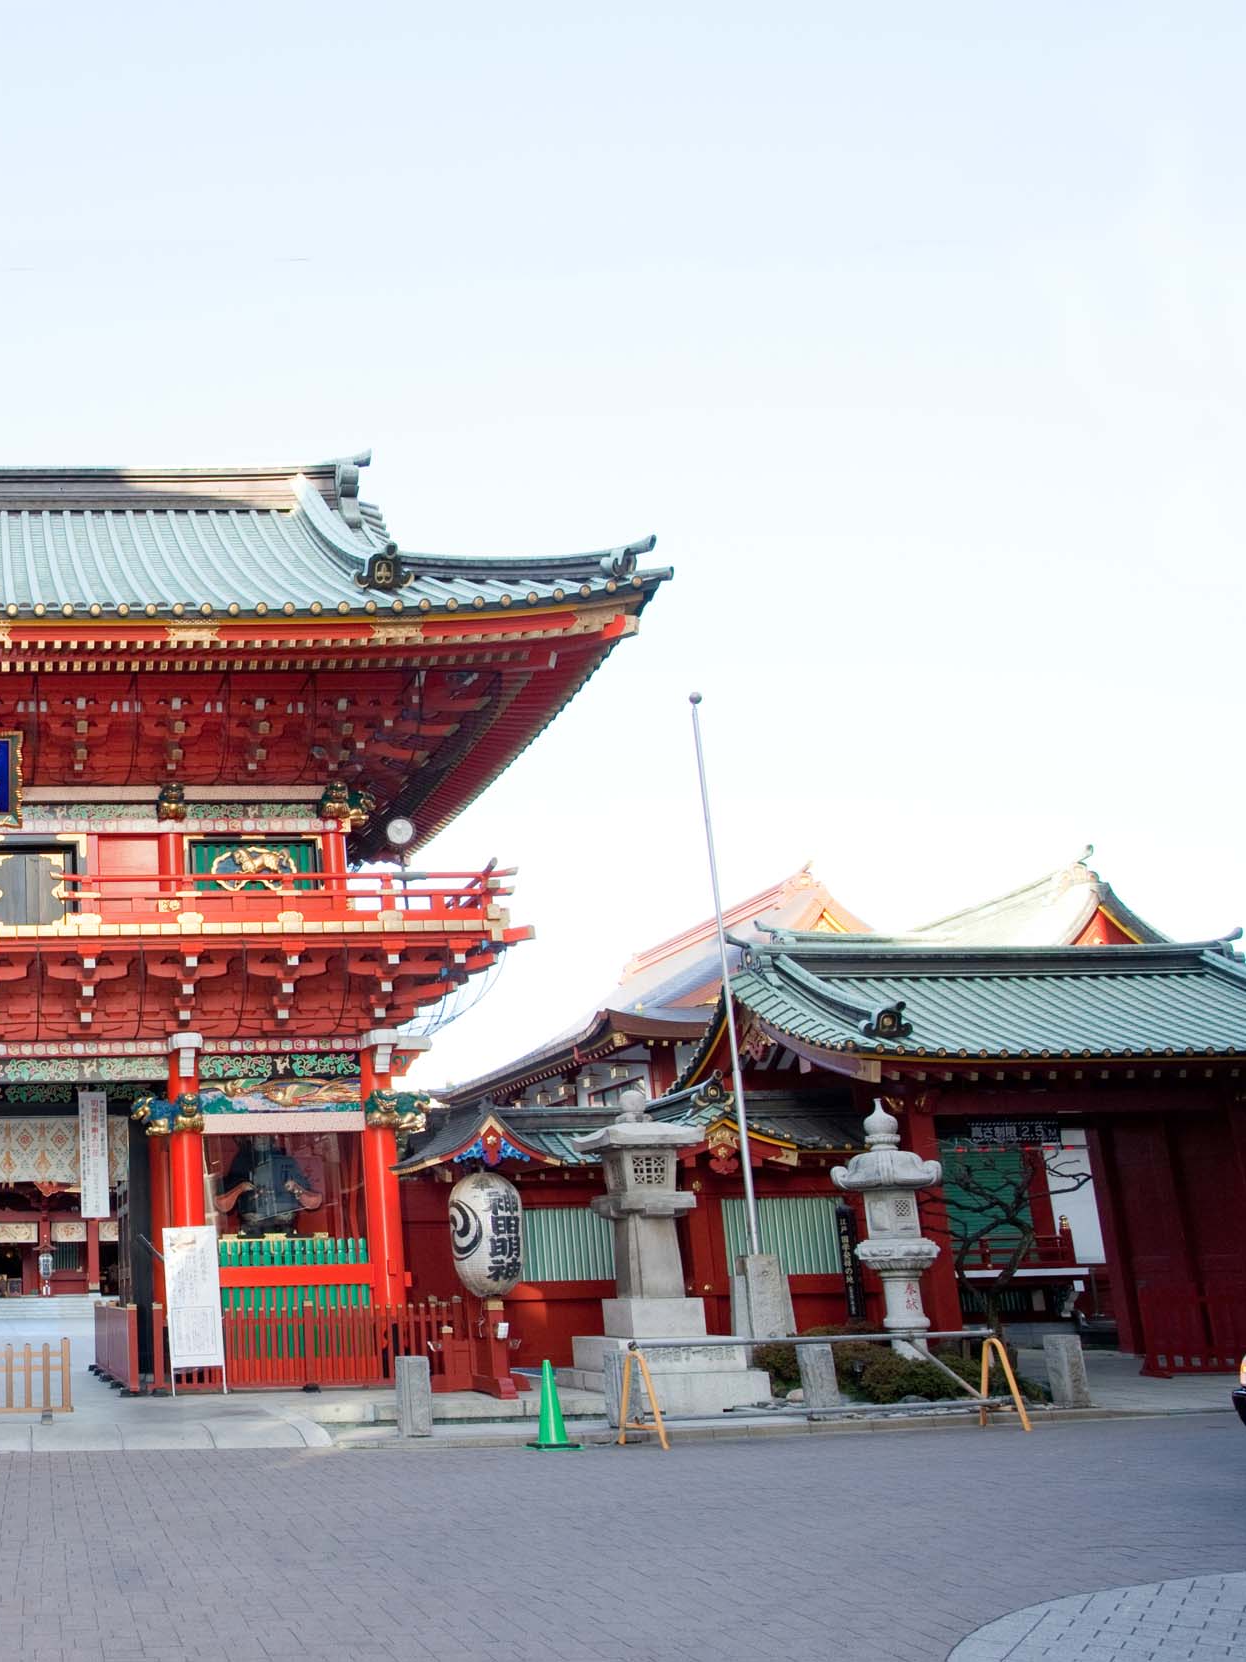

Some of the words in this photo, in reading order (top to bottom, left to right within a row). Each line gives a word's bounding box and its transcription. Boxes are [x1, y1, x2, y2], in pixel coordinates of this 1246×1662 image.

[971, 1126, 1017, 1138] 高さ制限
[1020, 1125, 1043, 1138] 2.5
[486, 1188, 521, 1281] 神田明神
[905, 1280, 919, 1312] 奉献
